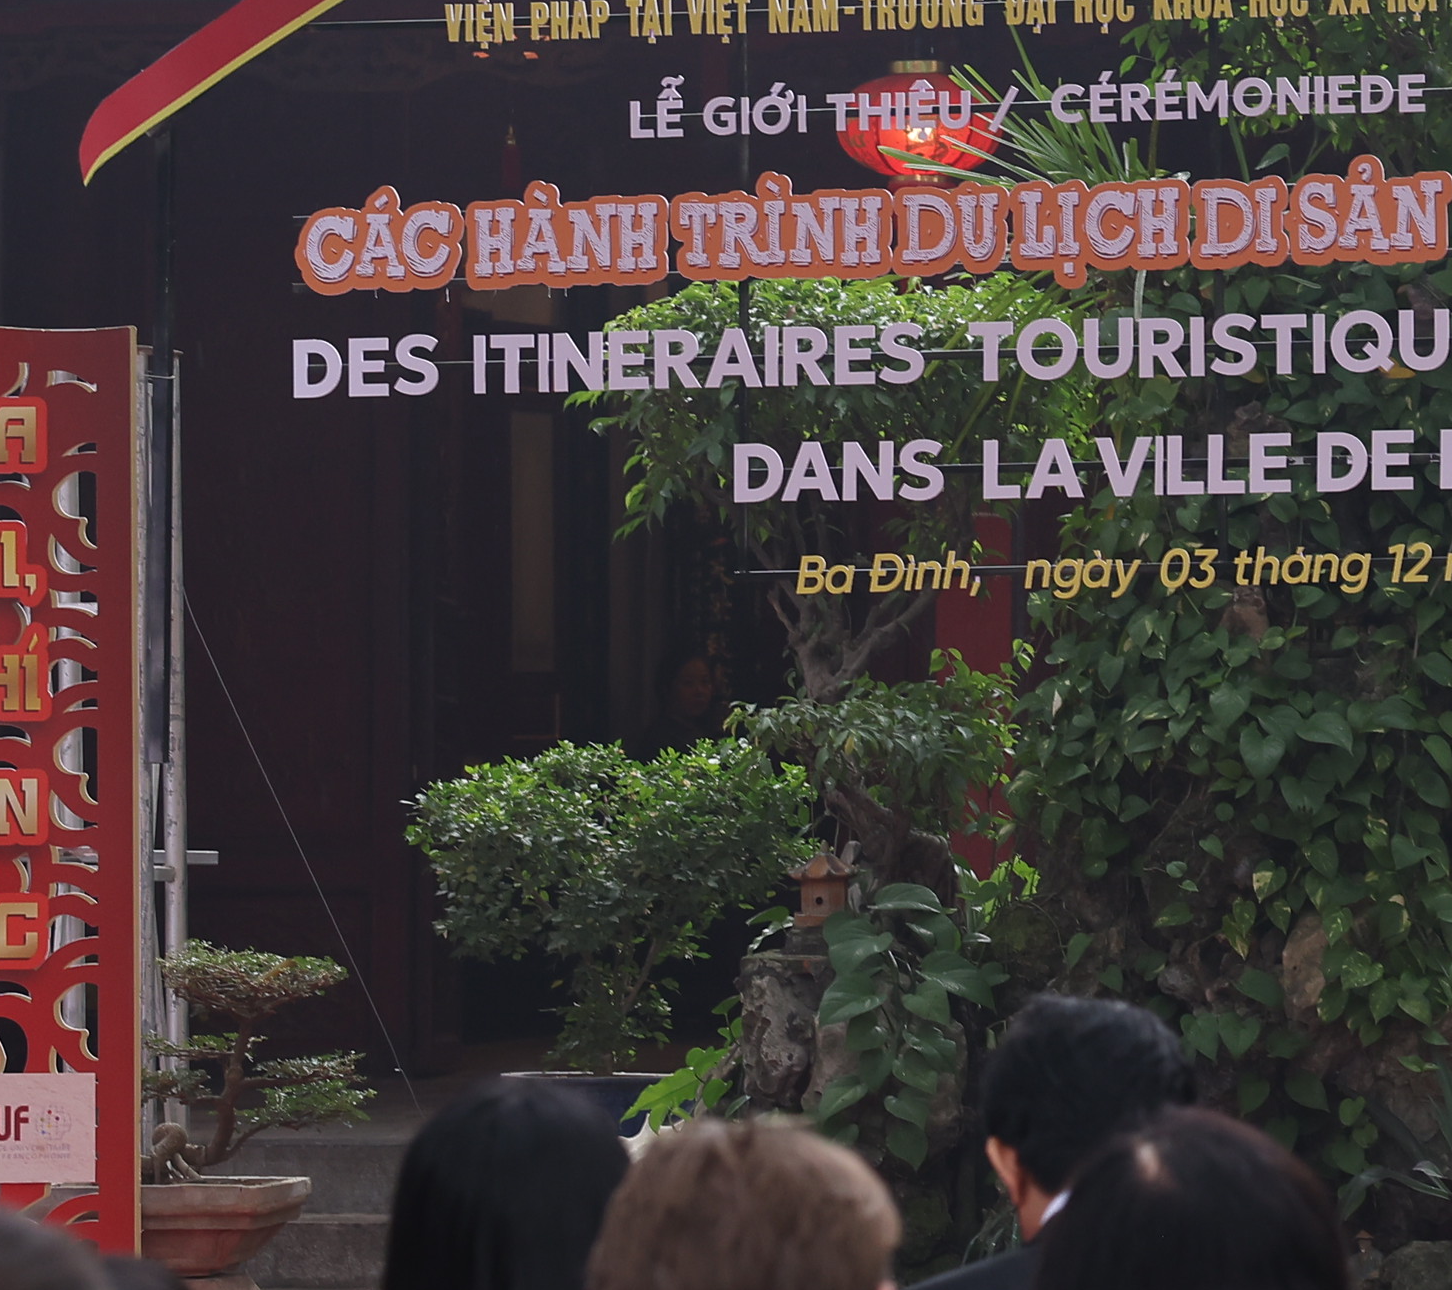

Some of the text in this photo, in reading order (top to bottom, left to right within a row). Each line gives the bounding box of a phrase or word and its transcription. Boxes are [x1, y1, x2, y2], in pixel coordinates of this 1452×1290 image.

[628, 75, 684, 139] LỄ
[703, 82, 808, 136] GIỚI
[825, 78, 972, 141] THIỆU
[1050, 70, 1426, 125] CÉRÉMONIEDE
[304, 190, 454, 282] CÁC
[473, 187, 659, 276] HÀNH
[678, 179, 884, 269] TRÌNH
[901, 191, 998, 261] DU
[1017, 182, 1182, 277] LỊCH
[1200, 183, 1278, 257] DI
[1298, 162, 1444, 255] SẢN
[292, 333, 439, 400] DES
[472, 321, 925, 395] ITINERAIRES
[732, 440, 944, 504] DANS
[982, 438, 1084, 500] LA
[1096, 433, 1292, 498] VILLE
[1316, 430, 1415, 492] DE
[796, 556, 855, 597] Ba
[869, 550, 981, 596] Đình,
[1024, 553, 1140, 599] ngày
[1159, 548, 1218, 589] 03
[1233, 544, 1372, 594] tháng
[1387, 542, 1434, 584] 12
